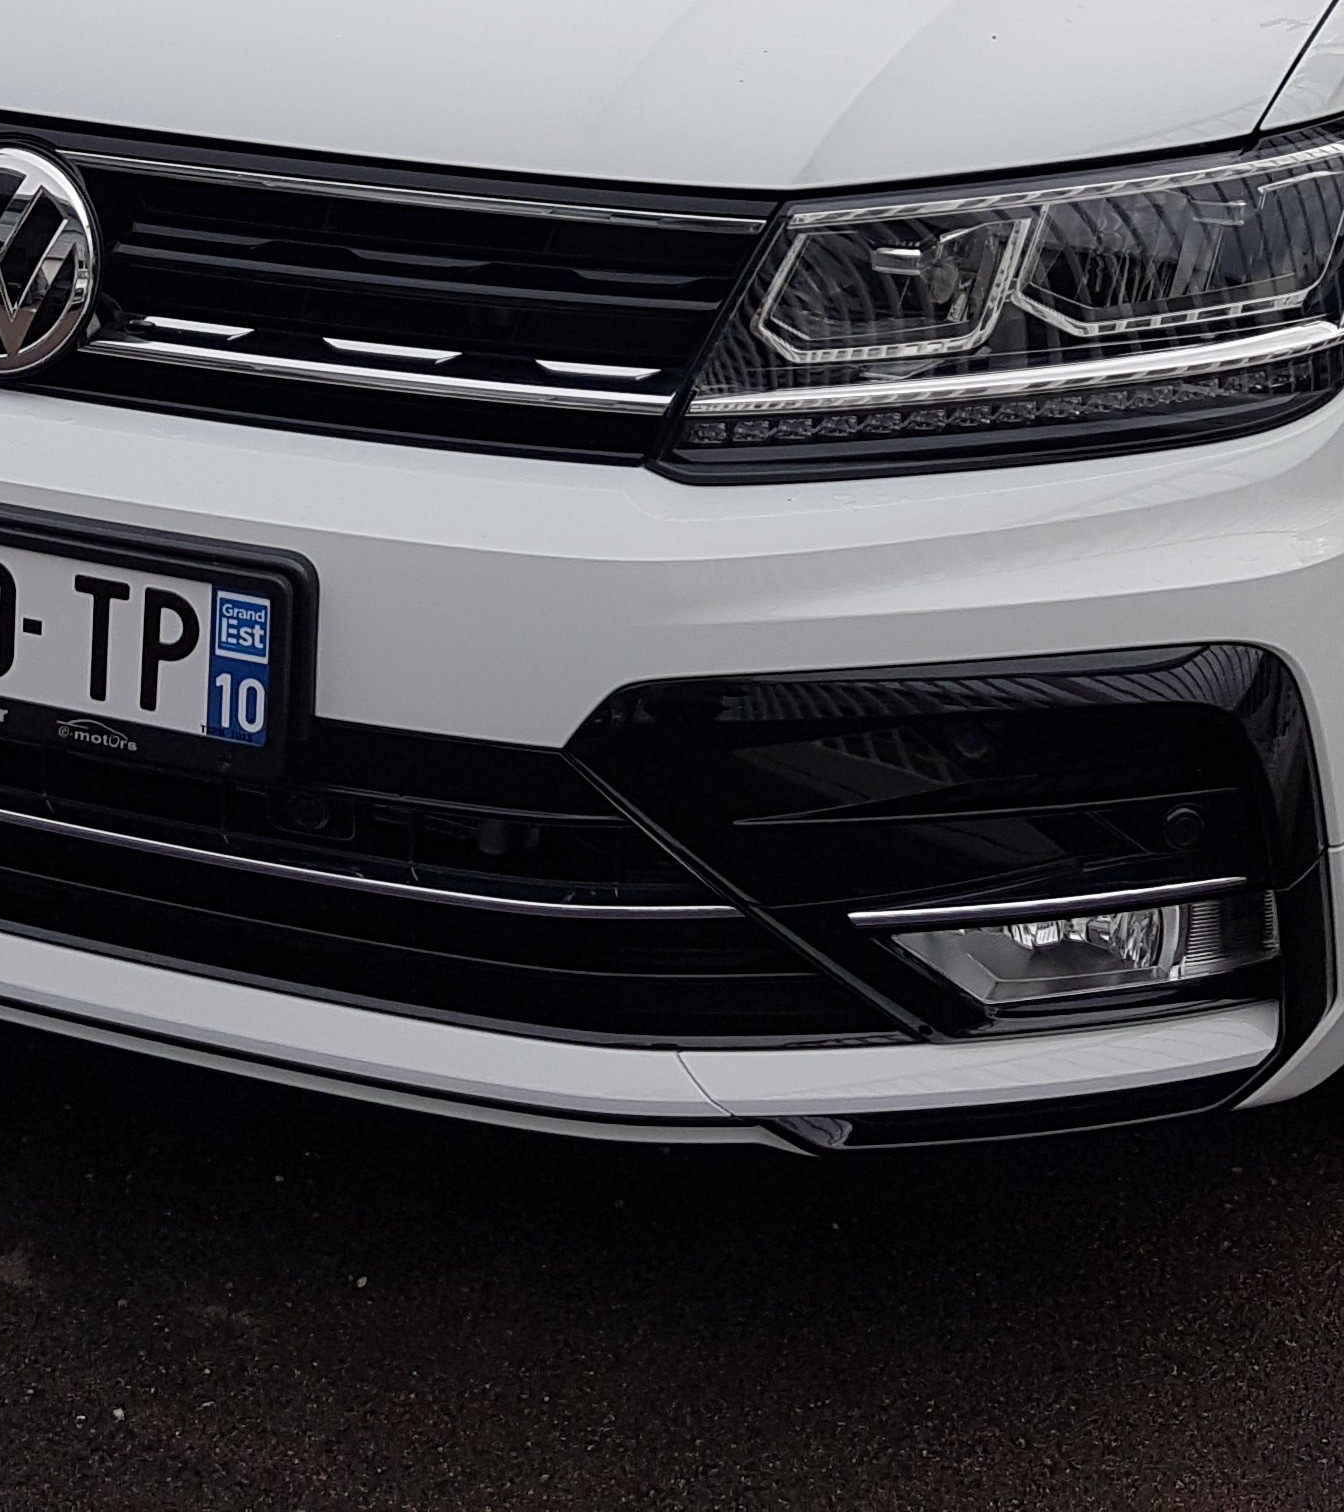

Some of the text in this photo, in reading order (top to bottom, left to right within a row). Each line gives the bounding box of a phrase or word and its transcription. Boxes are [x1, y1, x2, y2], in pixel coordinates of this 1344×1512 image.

[222, 603, 266, 623] Grand
[221, 617, 265, 649] Est
[215, 672, 266, 733] 10
